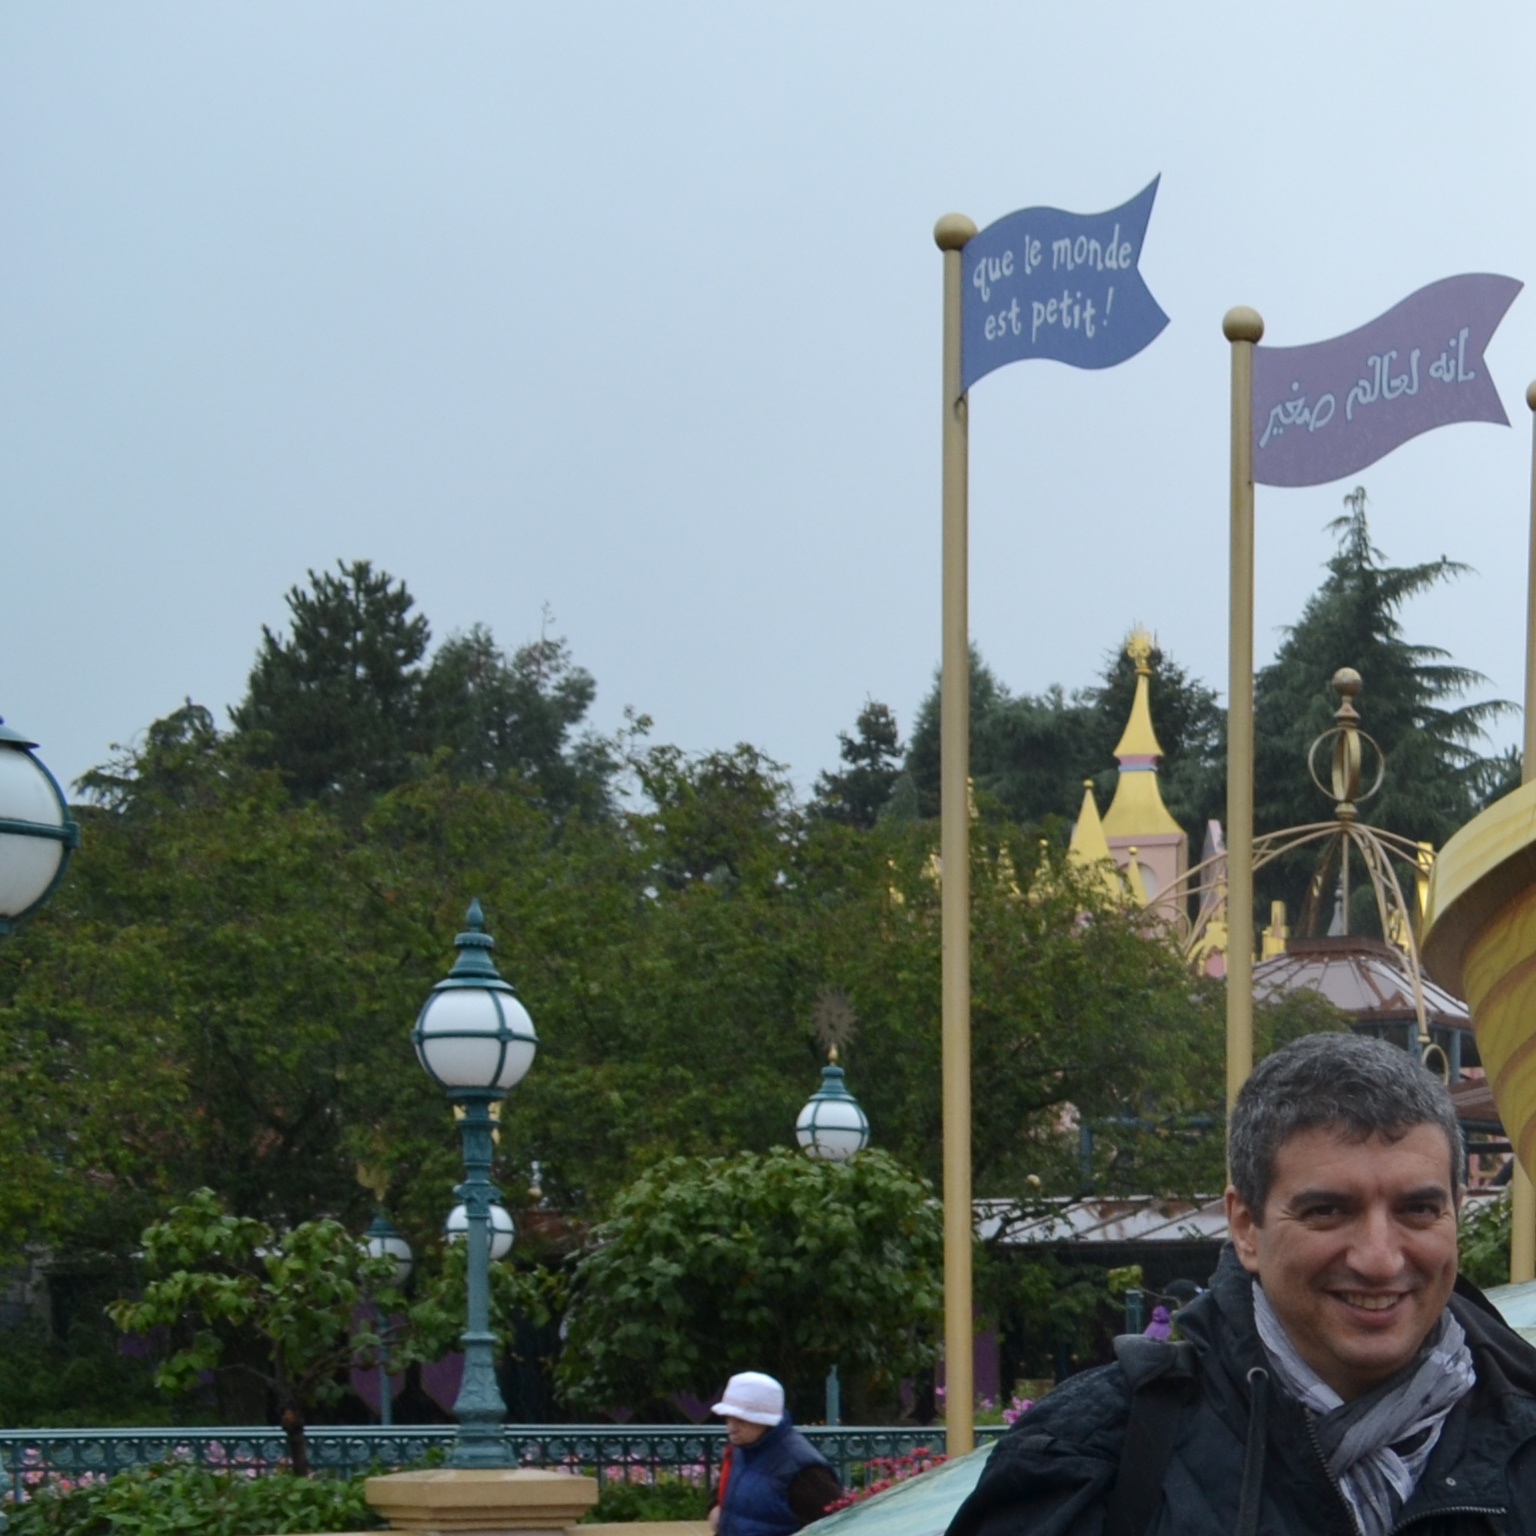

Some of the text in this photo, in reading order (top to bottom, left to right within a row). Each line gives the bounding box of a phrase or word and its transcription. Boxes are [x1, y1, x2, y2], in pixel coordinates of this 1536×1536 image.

[973, 223, 1132, 302] que le monde
[984, 297, 1021, 341] est
